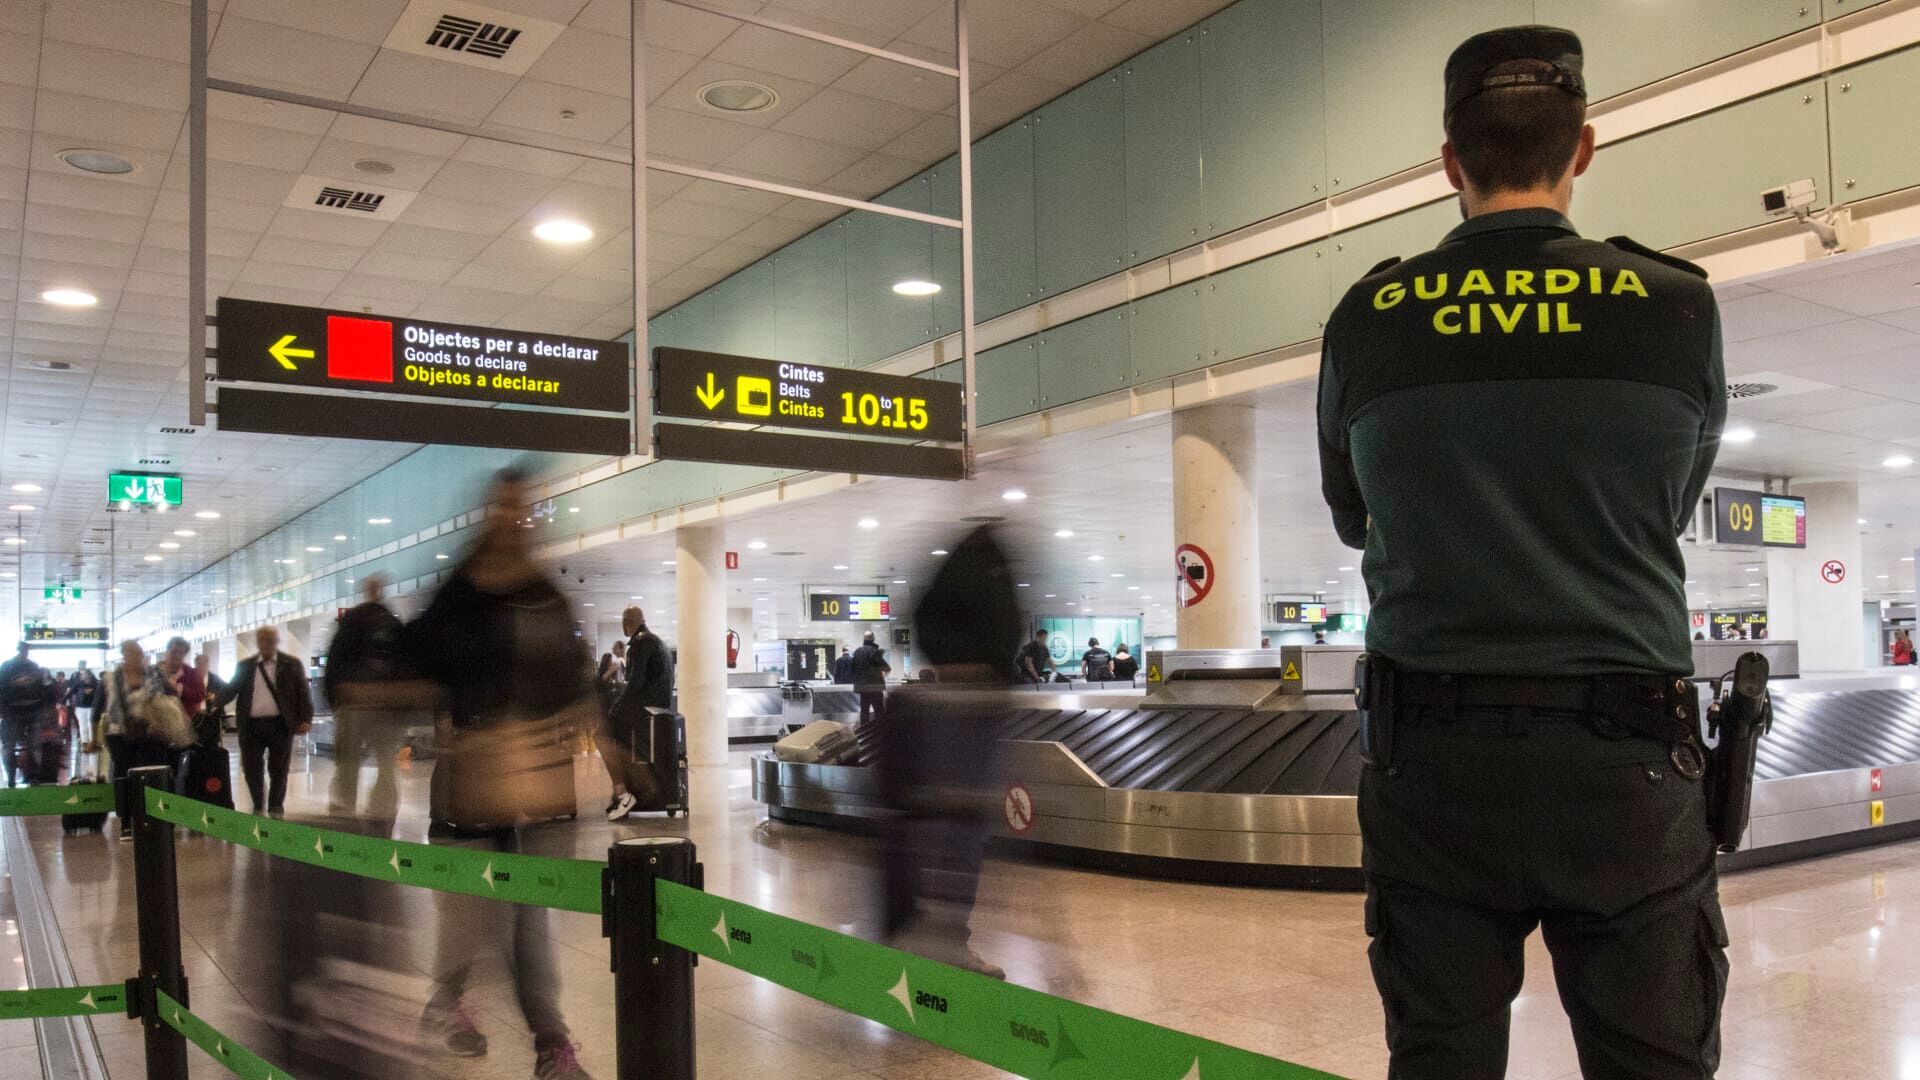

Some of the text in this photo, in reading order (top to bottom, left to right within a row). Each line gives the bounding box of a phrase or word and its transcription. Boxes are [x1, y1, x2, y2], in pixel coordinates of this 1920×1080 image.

[1373, 267, 1649, 310] GUARDIA
[1433, 302, 1582, 334] CIVIL
[404, 326, 599, 361] Objectes per a declarar
[404, 347, 527, 372] Goods to declare
[404, 365, 560, 393] Objetos a declarar
[779, 363, 824, 383] Cintes
[779, 382, 811, 399] Belts
[779, 399, 824, 418] Cintas
[841, 391, 929, 430] 10 to a 15
[1729, 502, 1753, 532] 09
[821, 600, 840, 616] 10
[1284, 607, 1296, 619] 10
[730, 927, 752, 944] aena
[915, 990, 948, 1013] aena
